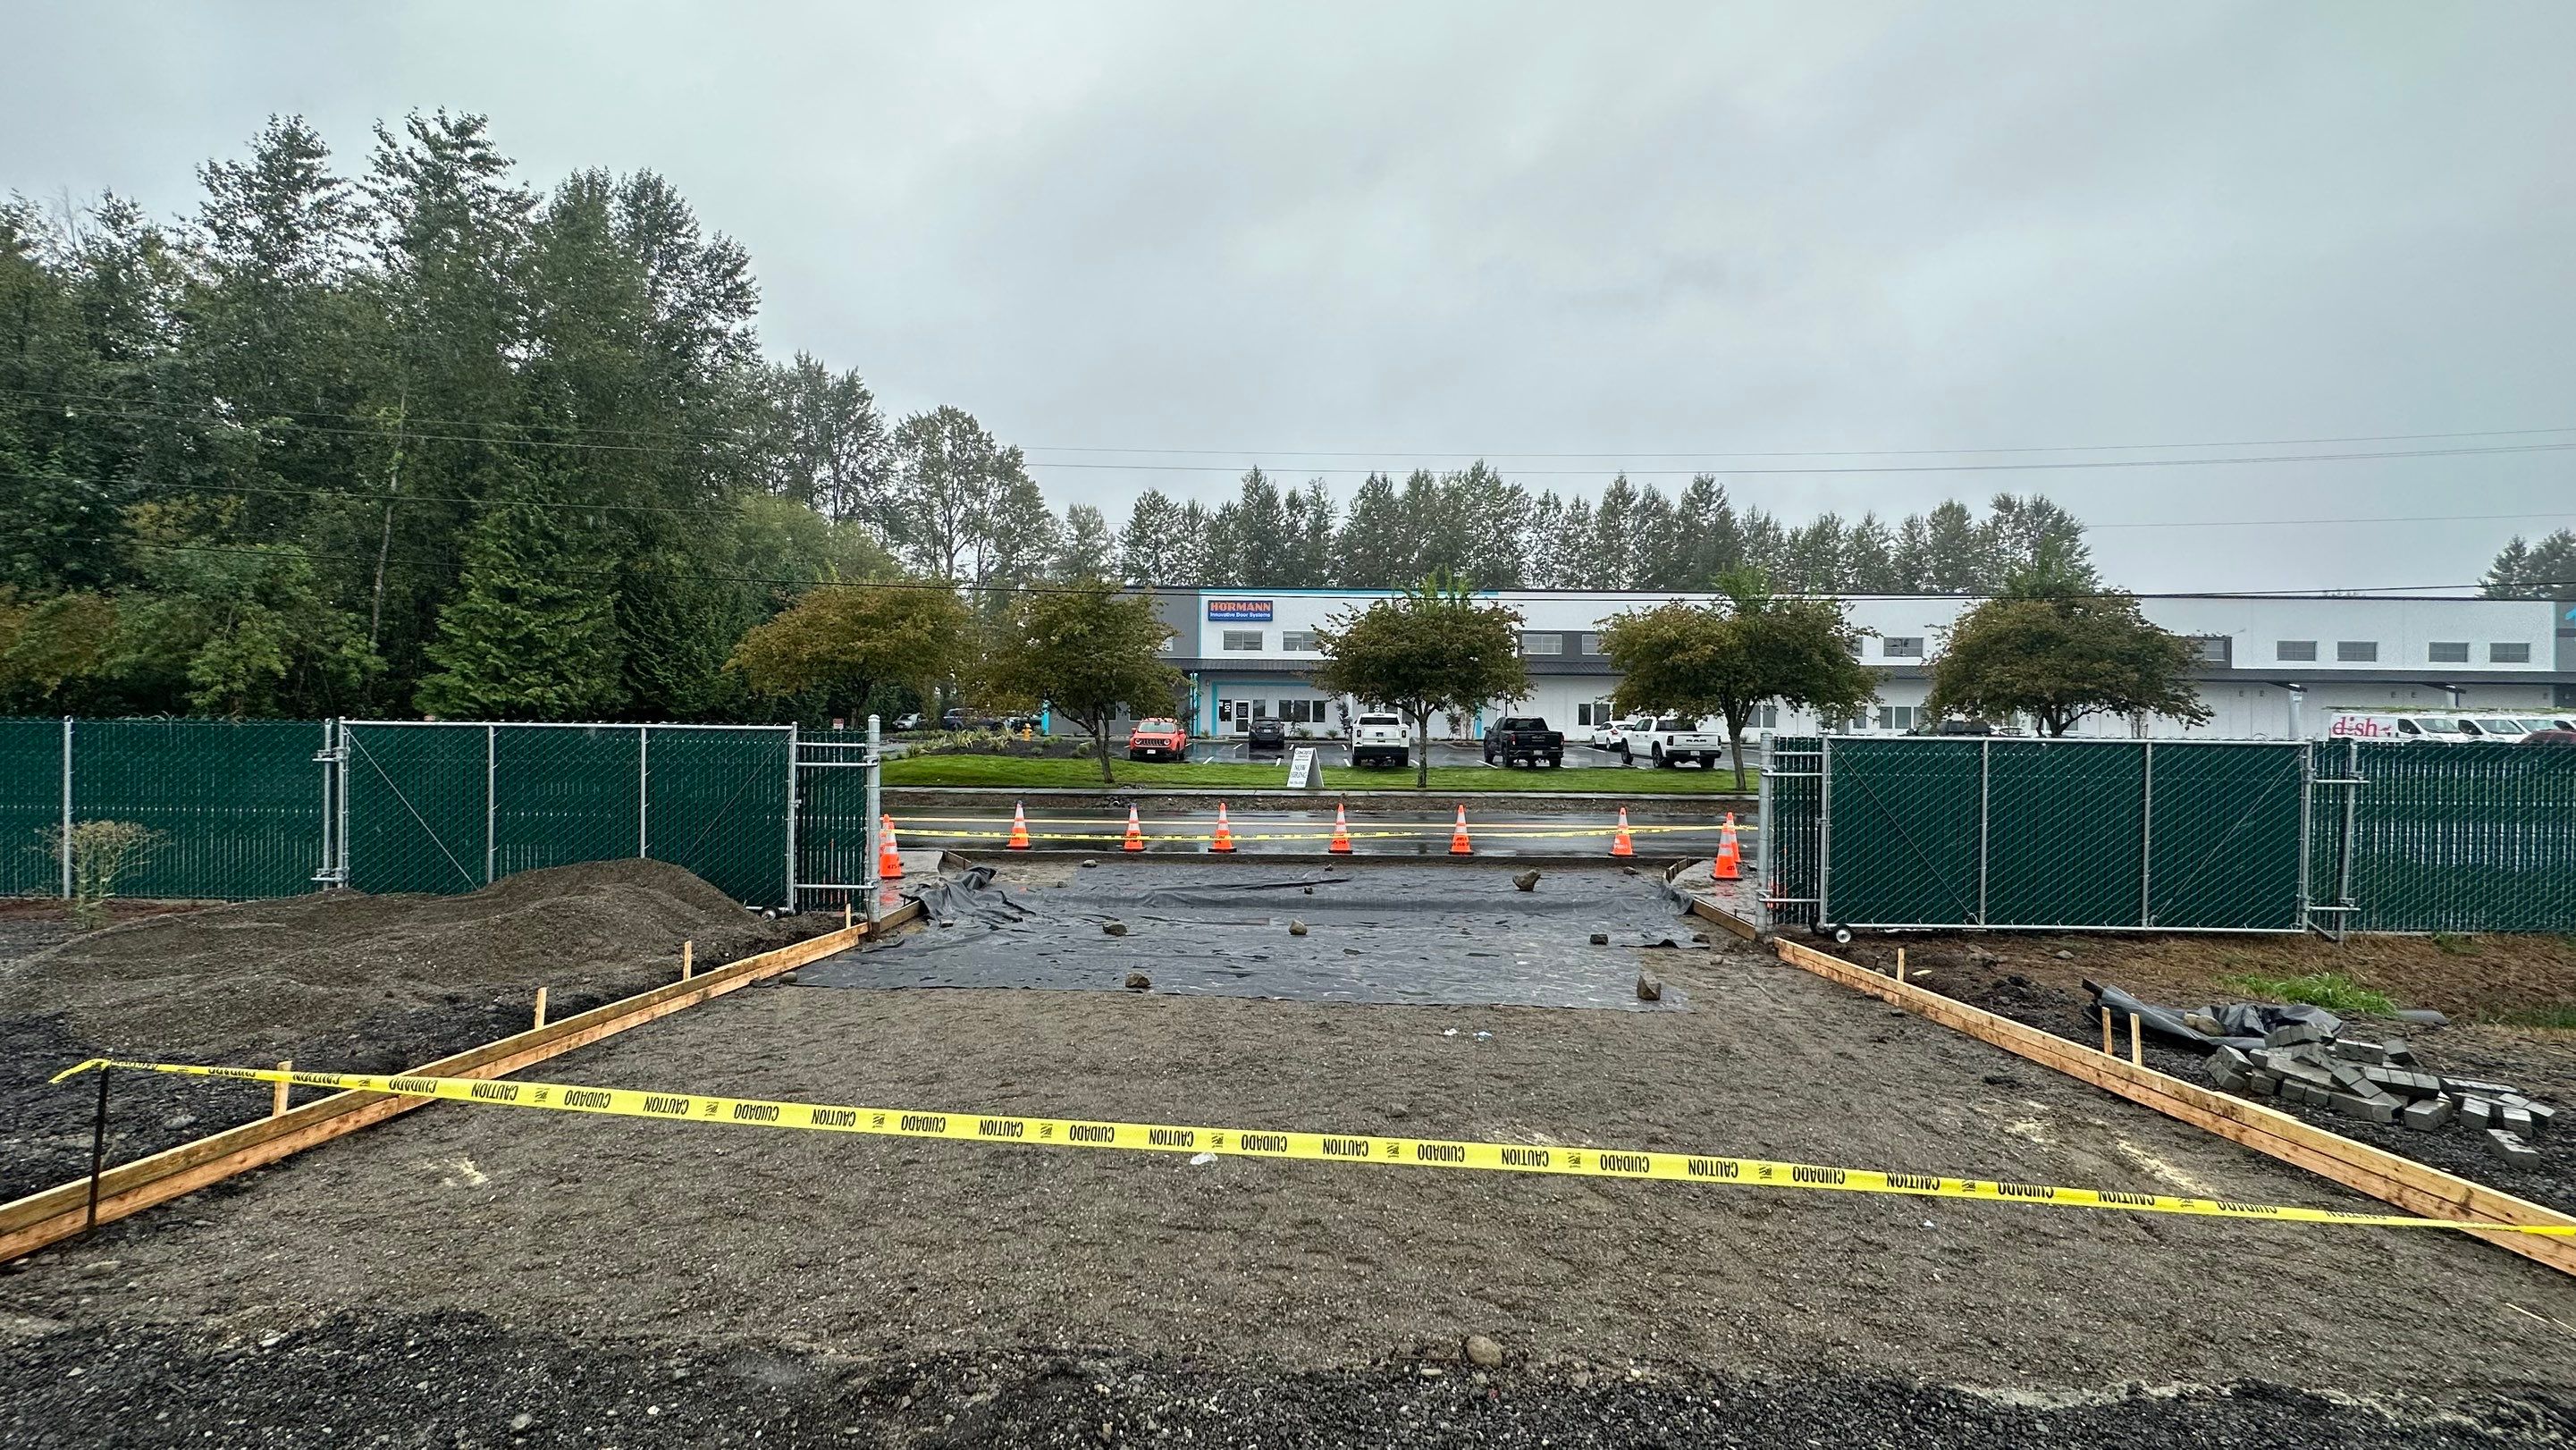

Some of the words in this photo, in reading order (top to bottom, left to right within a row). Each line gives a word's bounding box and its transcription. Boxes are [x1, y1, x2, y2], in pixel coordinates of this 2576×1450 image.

[2332, 717, 2378, 737] dish
[388, 1077, 438, 1093] CUIDADO
[470, 1082, 519, 1101] CAUTION
[563, 1089, 611, 1109] CUIDADO
[643, 1096, 690, 1116] CAUTION
[733, 1102, 780, 1122] CUIDADO
[811, 1108, 856, 1127] CAUTION
[900, 1114, 947, 1133] CUIDADO
[978, 1118, 1024, 1138] CAUTION
[1069, 1124, 1115, 1142] CUIDADO
[1149, 1128, 1195, 1148] CAUTION
[1241, 1134, 1288, 1152] CUIDADO
[1322, 1138, 1369, 1158] CAUTION
[1417, 1143, 1466, 1163] CUIDADO
[1501, 1148, 1550, 1168] CAUTION
[1599, 1153, 1651, 1173] CUIDADO
[1688, 1159, 1739, 1178] CAUTION
[1792, 1166, 1847, 1185] CUIDADO
[1886, 1172, 1940, 1191] CAUTION
